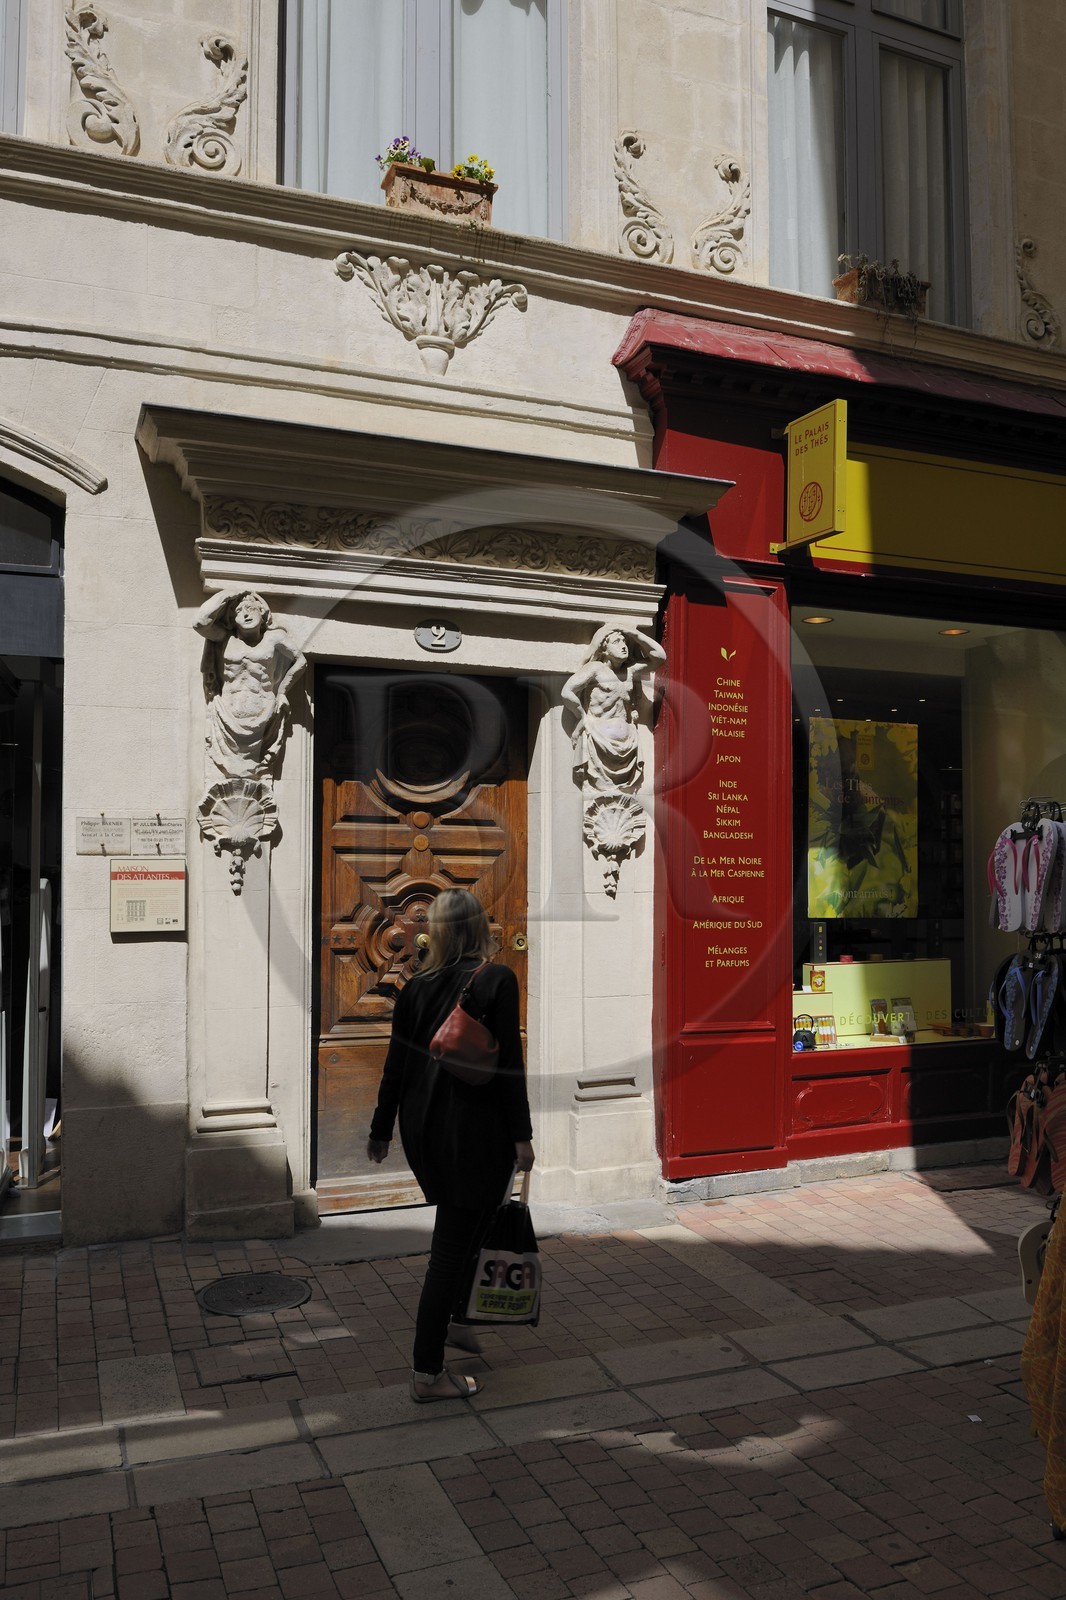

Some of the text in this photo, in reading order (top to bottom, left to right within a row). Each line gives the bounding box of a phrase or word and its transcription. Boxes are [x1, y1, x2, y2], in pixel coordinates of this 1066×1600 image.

[795, 421, 830, 445] LE PALAIS
[795, 434, 829, 457] DES THÉS
[431, 624, 446, 647] 2
[716, 677, 741, 687] CHINE
[713, 689, 744, 700] TAIWAN
[708, 702, 749, 713] INDONÉSIE
[711, 728, 745, 738] MALAISIE
[716, 753, 741, 764] JAPON
[719, 779, 738, 789] INDE
[707, 791, 749, 802] SRI LANKA
[716, 804, 741, 814] NÉPAL
[716, 817, 741, 826] SIKKIM
[703, 829, 754, 840] BANGLADESH
[693, 855, 762, 865] DE LA MER NOIRE
[117, 873, 132, 881] DES
[132, 873, 170, 881] ATLANTES
[690, 867, 765, 878] À LA MER CASPIENNE
[711, 895, 745, 904] AFRIQUE
[692, 920, 763, 929] AMÉRIQUE DU SUD
[707, 944, 748, 955] MÉLANGES
[705, 958, 750, 968] ET PARFUMS
[839, 1010, 920, 1026] DÉCOUVERTE
[926, 1009, 947, 1020] DES
[480, 1260, 535, 1291] SAGA
